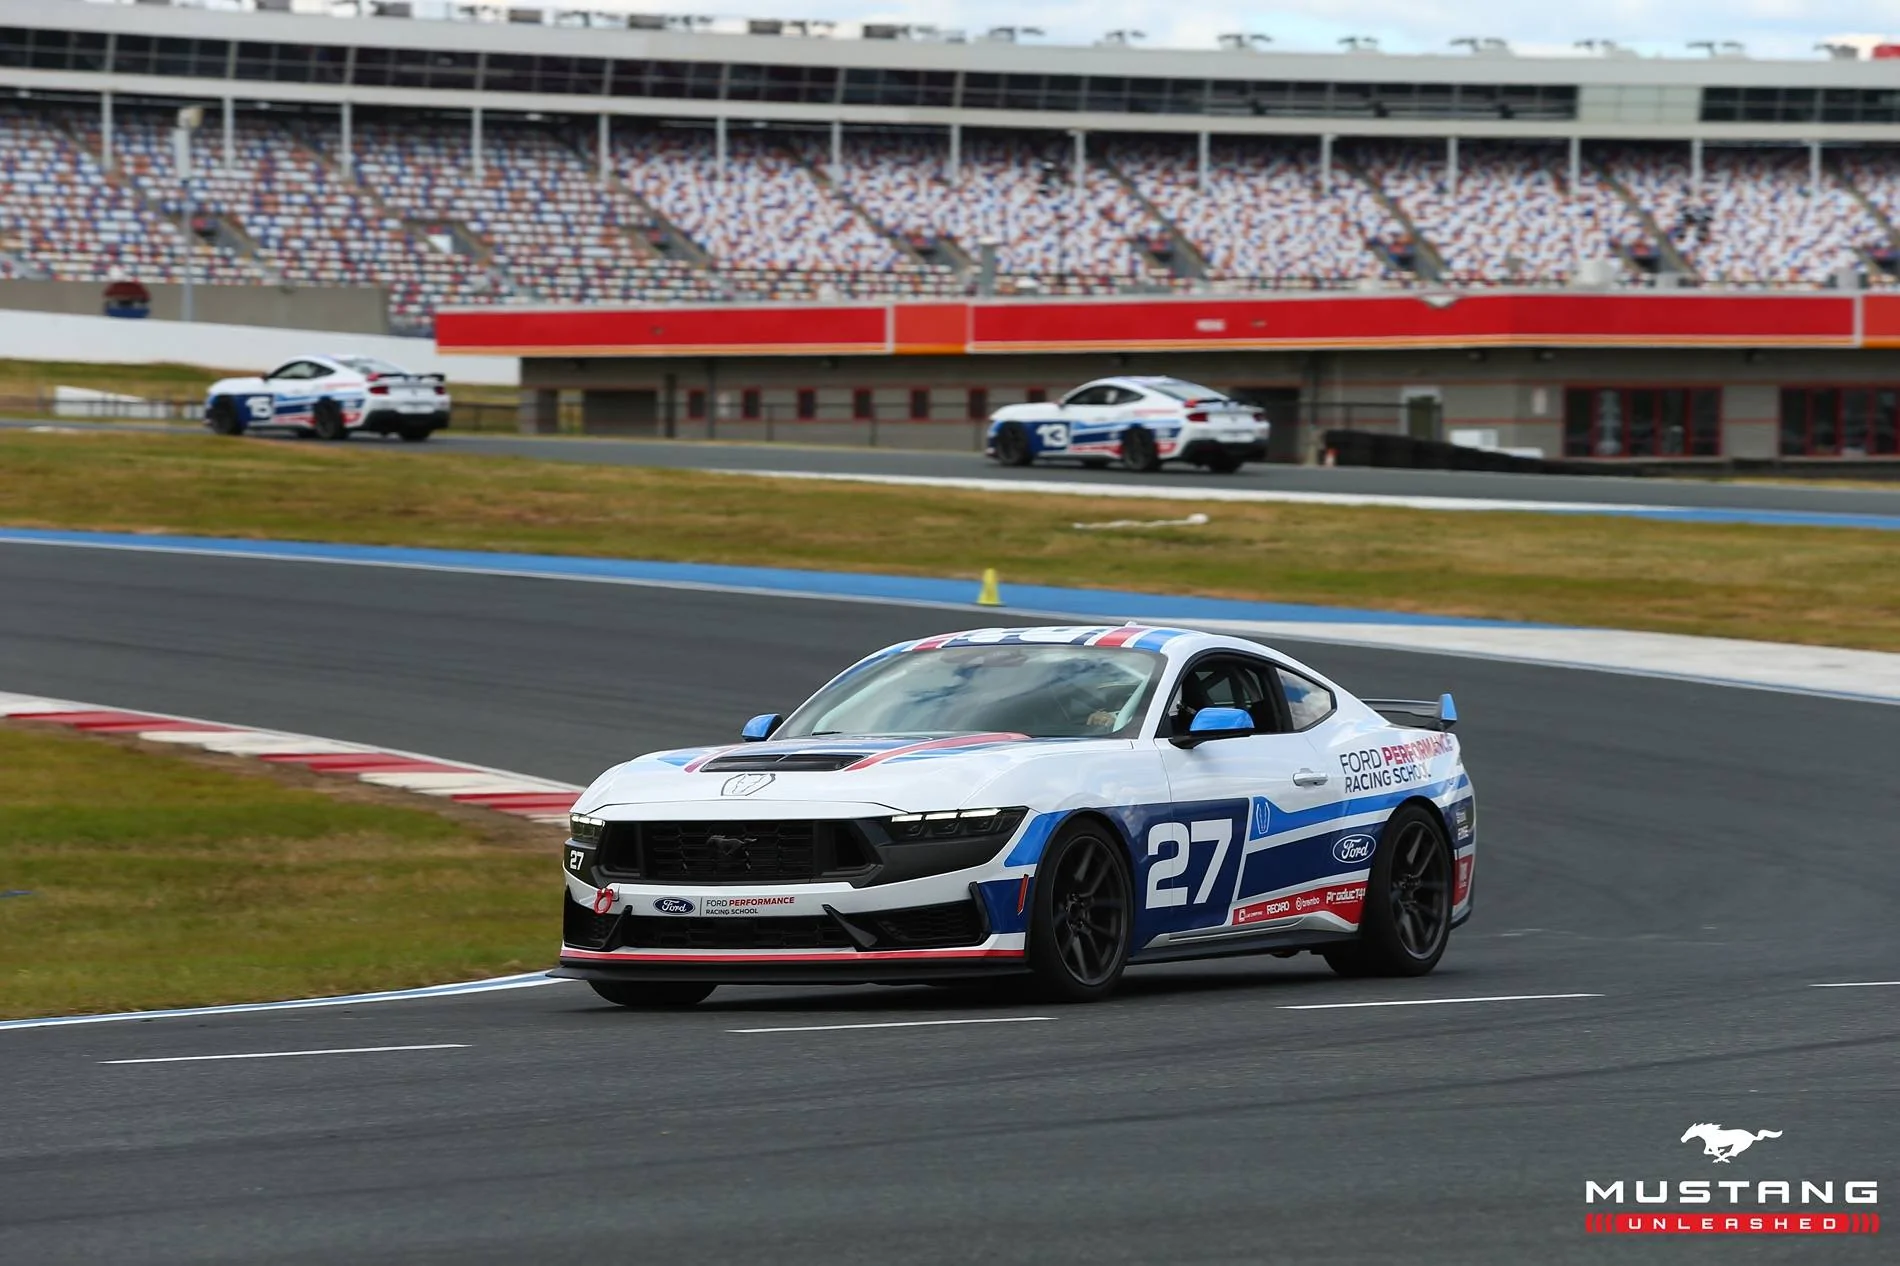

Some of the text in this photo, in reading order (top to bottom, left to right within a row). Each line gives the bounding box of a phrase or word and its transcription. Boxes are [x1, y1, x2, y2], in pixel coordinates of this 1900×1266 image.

[1036, 423, 1067, 448] 13
[1340, 748, 1382, 775] FORD
[1345, 770, 1391, 794] RACING
[1340, 838, 1370, 860] Ford
[569, 850, 584, 871] 27
[1146, 818, 1233, 910] 27
[661, 899, 687, 912] Ford
[706, 896, 795, 907] FORD PERFORMANCE
[706, 908, 730, 916] RACING
[1266, 901, 1290, 915] RECARO
[1301, 897, 1320, 908] brembo
